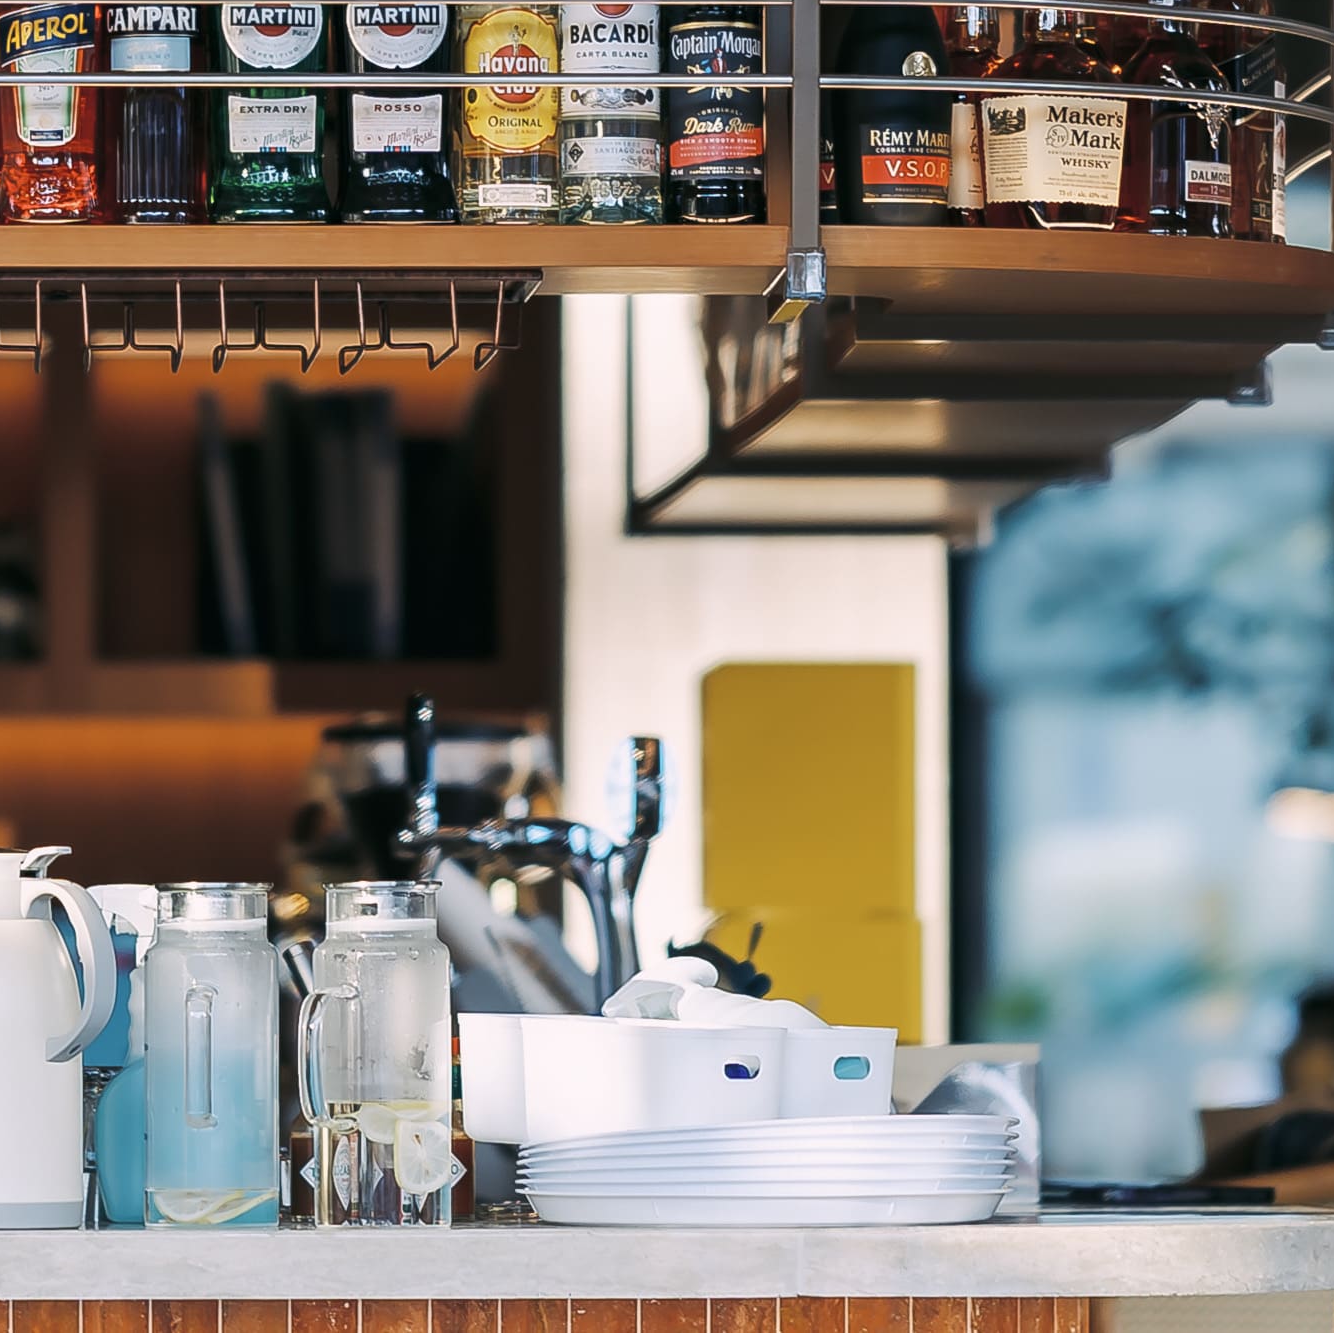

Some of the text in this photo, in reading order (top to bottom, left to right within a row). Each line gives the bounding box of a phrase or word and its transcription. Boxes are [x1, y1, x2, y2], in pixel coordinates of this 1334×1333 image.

[106, 6, 197, 33] CAMPARI
[232, 8, 313, 25] MARTINI
[356, 7, 437, 24] MARTINI
[5, 12, 88, 54] APEROL
[570, 19, 655, 45] BACARDÍ
[671, 31, 761, 59] Captain Morgan
[479, 52, 549, 73] Havana
[576, 50, 649, 59] CARTA BLANCA
[239, 105, 280, 113] EXTRA
[374, 104, 422, 112] ROSSO
[488, 116, 543, 127] ORIGINAL
[1046, 106, 1124, 128] Maker's
[683, 117, 755, 135] Dark Rum
[870, 128, 913, 147] RÉMY
[1069, 129, 1121, 150] Mark
[1061, 157, 1111, 169] WHISKY
[1190, 169, 1230, 184] DALMORE
[1210, 184, 1219, 194] 12
